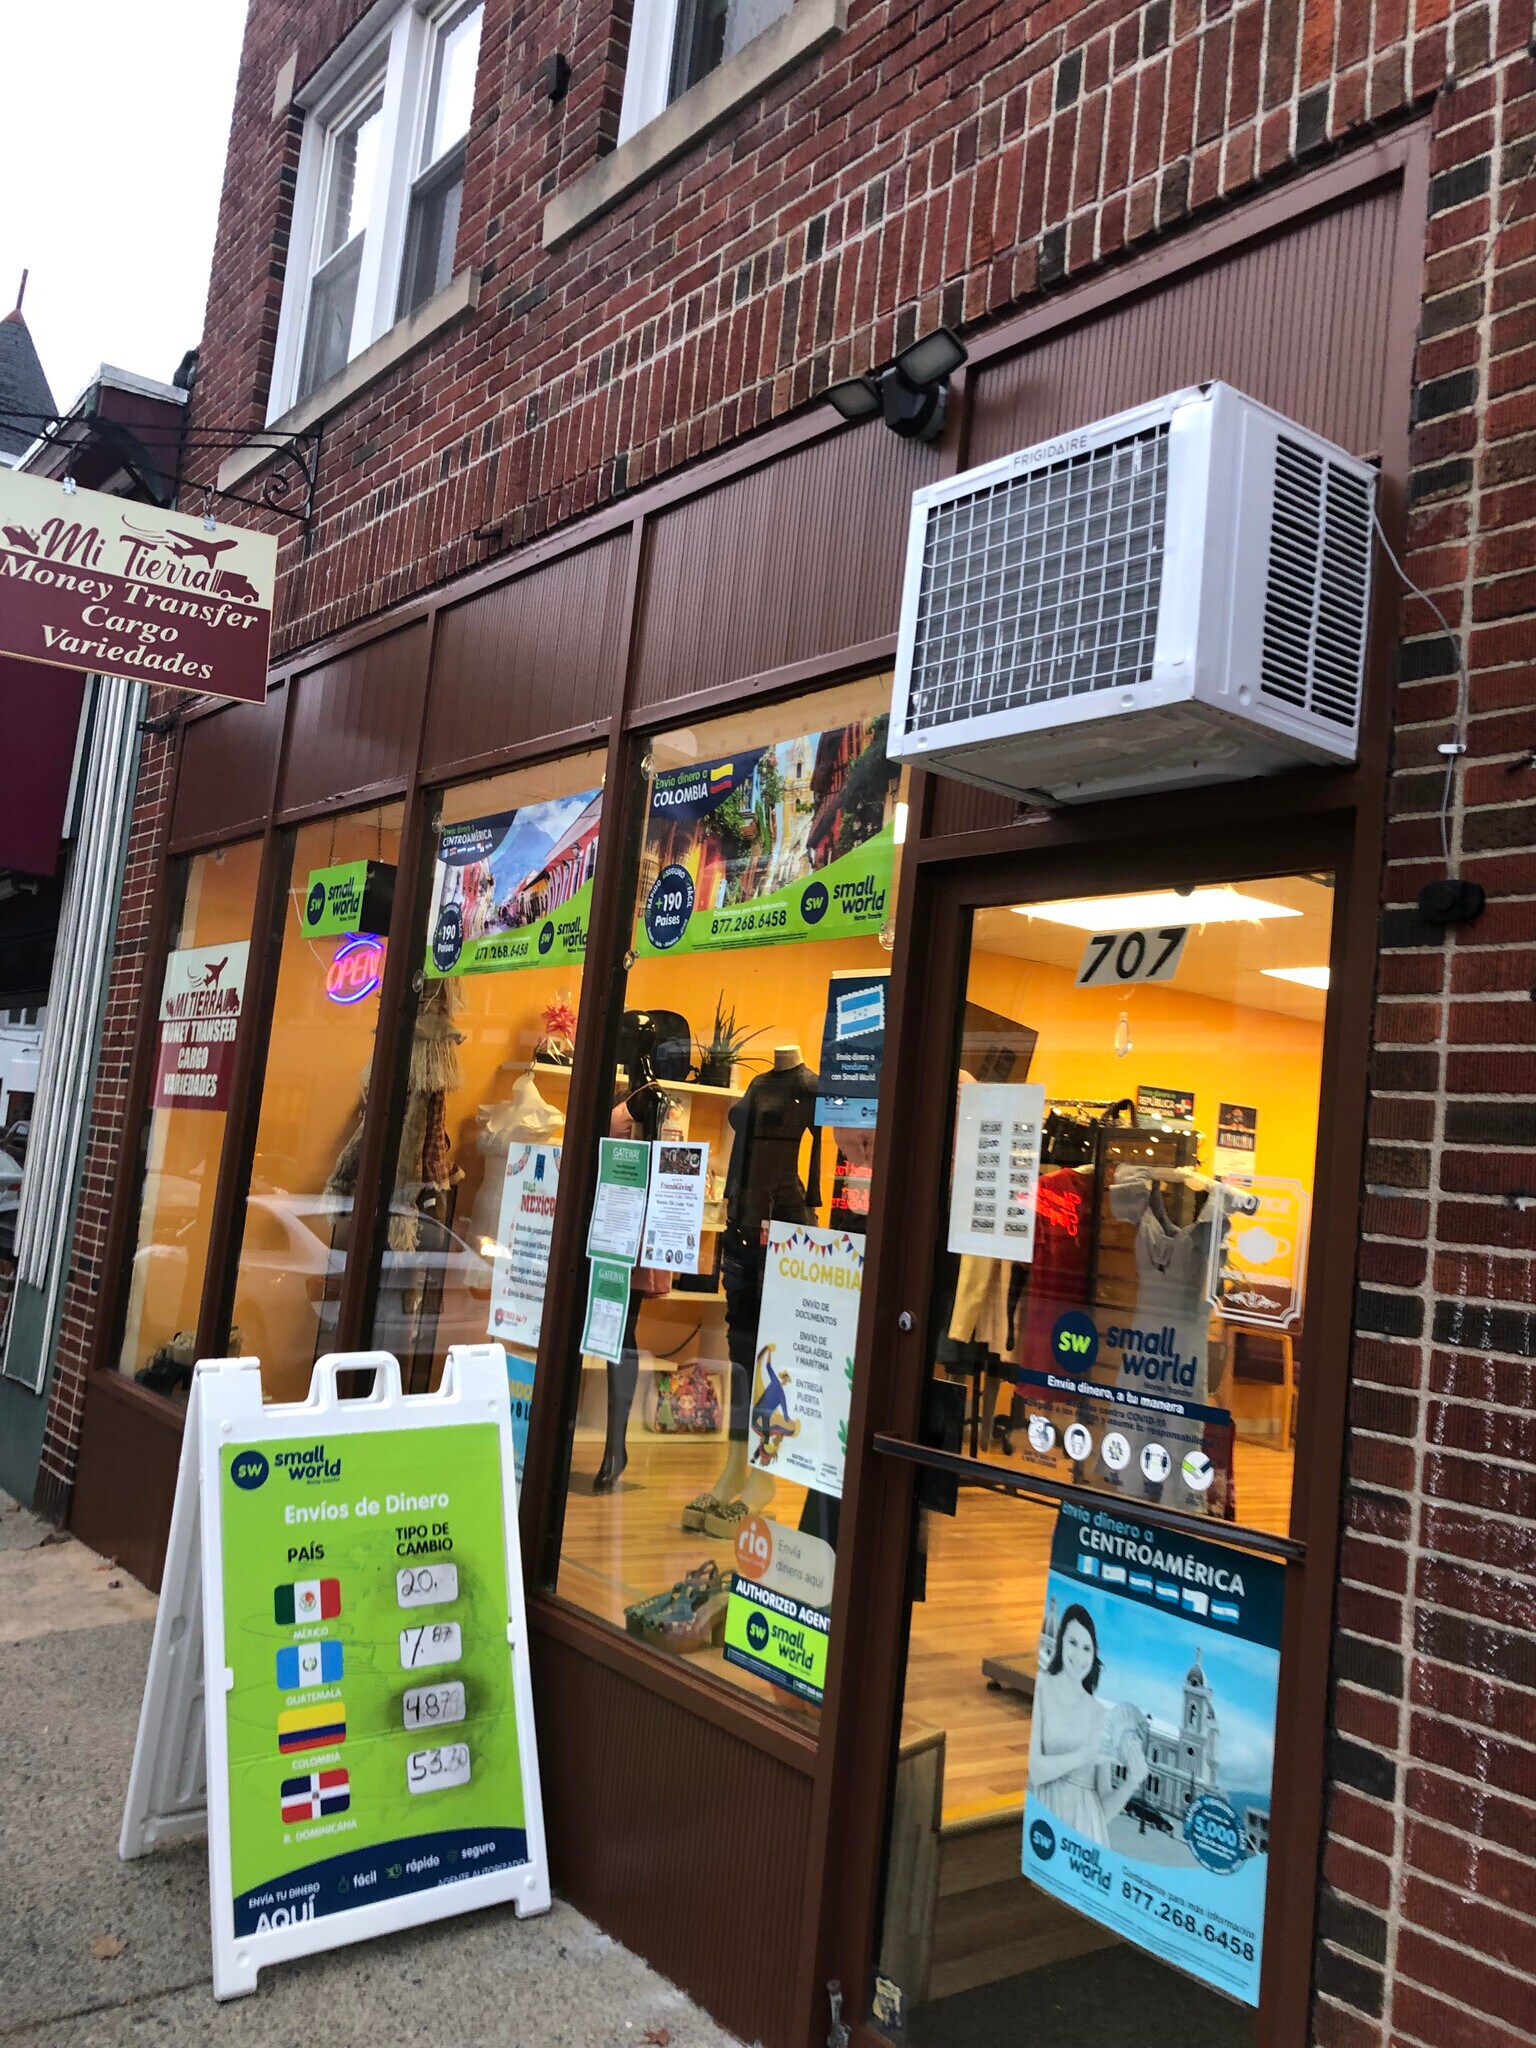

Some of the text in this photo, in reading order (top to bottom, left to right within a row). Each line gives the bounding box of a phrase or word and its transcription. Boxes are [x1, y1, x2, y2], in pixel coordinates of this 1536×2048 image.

[1012, 433, 1089, 470] FRIGIDAIRE
[41, 518, 212, 592] Mi Tierra
[1, 553, 259, 629] Money Transfer
[81, 605, 180, 643] Cargo
[41, 624, 214, 679] Variedades
[677, 770, 702, 787] dinero
[653, 782, 708, 808] COLOMBIA
[442, 828, 493, 847] CENTROAMÉRICA
[327, 877, 355, 900] small
[833, 875, 874, 900] small
[332, 892, 360, 916] world
[655, 891, 682, 911] +190
[842, 889, 885, 914] world
[557, 916, 581, 935] small
[711, 909, 787, 935] 877.268.6458
[1080, 927, 1186, 983] 707
[326, 946, 383, 992] OPEN
[174, 987, 225, 1016] MI TIERRA
[161, 1018, 237, 1044] MONEY TRANSFER
[177, 1046, 209, 1069] CARGO
[841, 1062, 868, 1071] Honduras
[163, 1073, 218, 1097] VARIEDADES
[842, 1072, 858, 1081] Small
[859, 1072, 876, 1081] World
[613, 1146, 640, 1160] GATEWAY
[778, 1256, 861, 1291] COLOMBIA
[795, 1309, 838, 1327] DOCUMENTOS
[821, 1302, 829, 1312] DE
[792, 1342, 833, 1360] CARGA AÉREA
[819, 1335, 827, 1345] DE
[1106, 1325, 1176, 1358] small
[800, 1357, 829, 1372] MARÍTIMA
[1122, 1351, 1198, 1388] world
[795, 1378, 823, 1394] ENTREGA
[796, 1391, 820, 1406] PUERTA
[799, 1405, 822, 1420] PUERTA
[1116, 1391, 1125, 1401] a
[1126, 1391, 1139, 1406] tu
[1140, 1395, 1185, 1415] manera
[274, 1444, 325, 1468] small
[288, 1458, 342, 1482] world
[284, 1492, 449, 1525] Envíos de Dinero
[395, 1522, 450, 1542] TIPO DE
[738, 1521, 768, 1559] ria
[1092, 1511, 1141, 1539] dinero
[1144, 1530, 1154, 1544] a
[287, 1541, 325, 1563] PAÍS
[396, 1538, 453, 1557] CAMBIO
[777, 1539, 802, 1560] Envía
[1079, 1526, 1246, 1597] CENTROAMÉRICA
[775, 1562, 824, 1589] dinero aquí
[735, 1579, 797, 1617] AUTHORIZED
[771, 1623, 805, 1650] small
[778, 1643, 814, 1670] world
[286, 1688, 342, 1706] GUATEMALA
[292, 1750, 341, 1770] COLOMBIA
[295, 1818, 357, 1843] DOMINICANA
[1060, 1836, 1100, 1867] small
[353, 1841, 496, 1889] fácil rápido seguro
[1069, 1855, 1112, 1890] world
[248, 1882, 320, 1909] ENVÍA TU DINERO
[255, 1894, 315, 1934] AQUÍ
[1121, 1881, 1255, 1962] 877.268.6458
